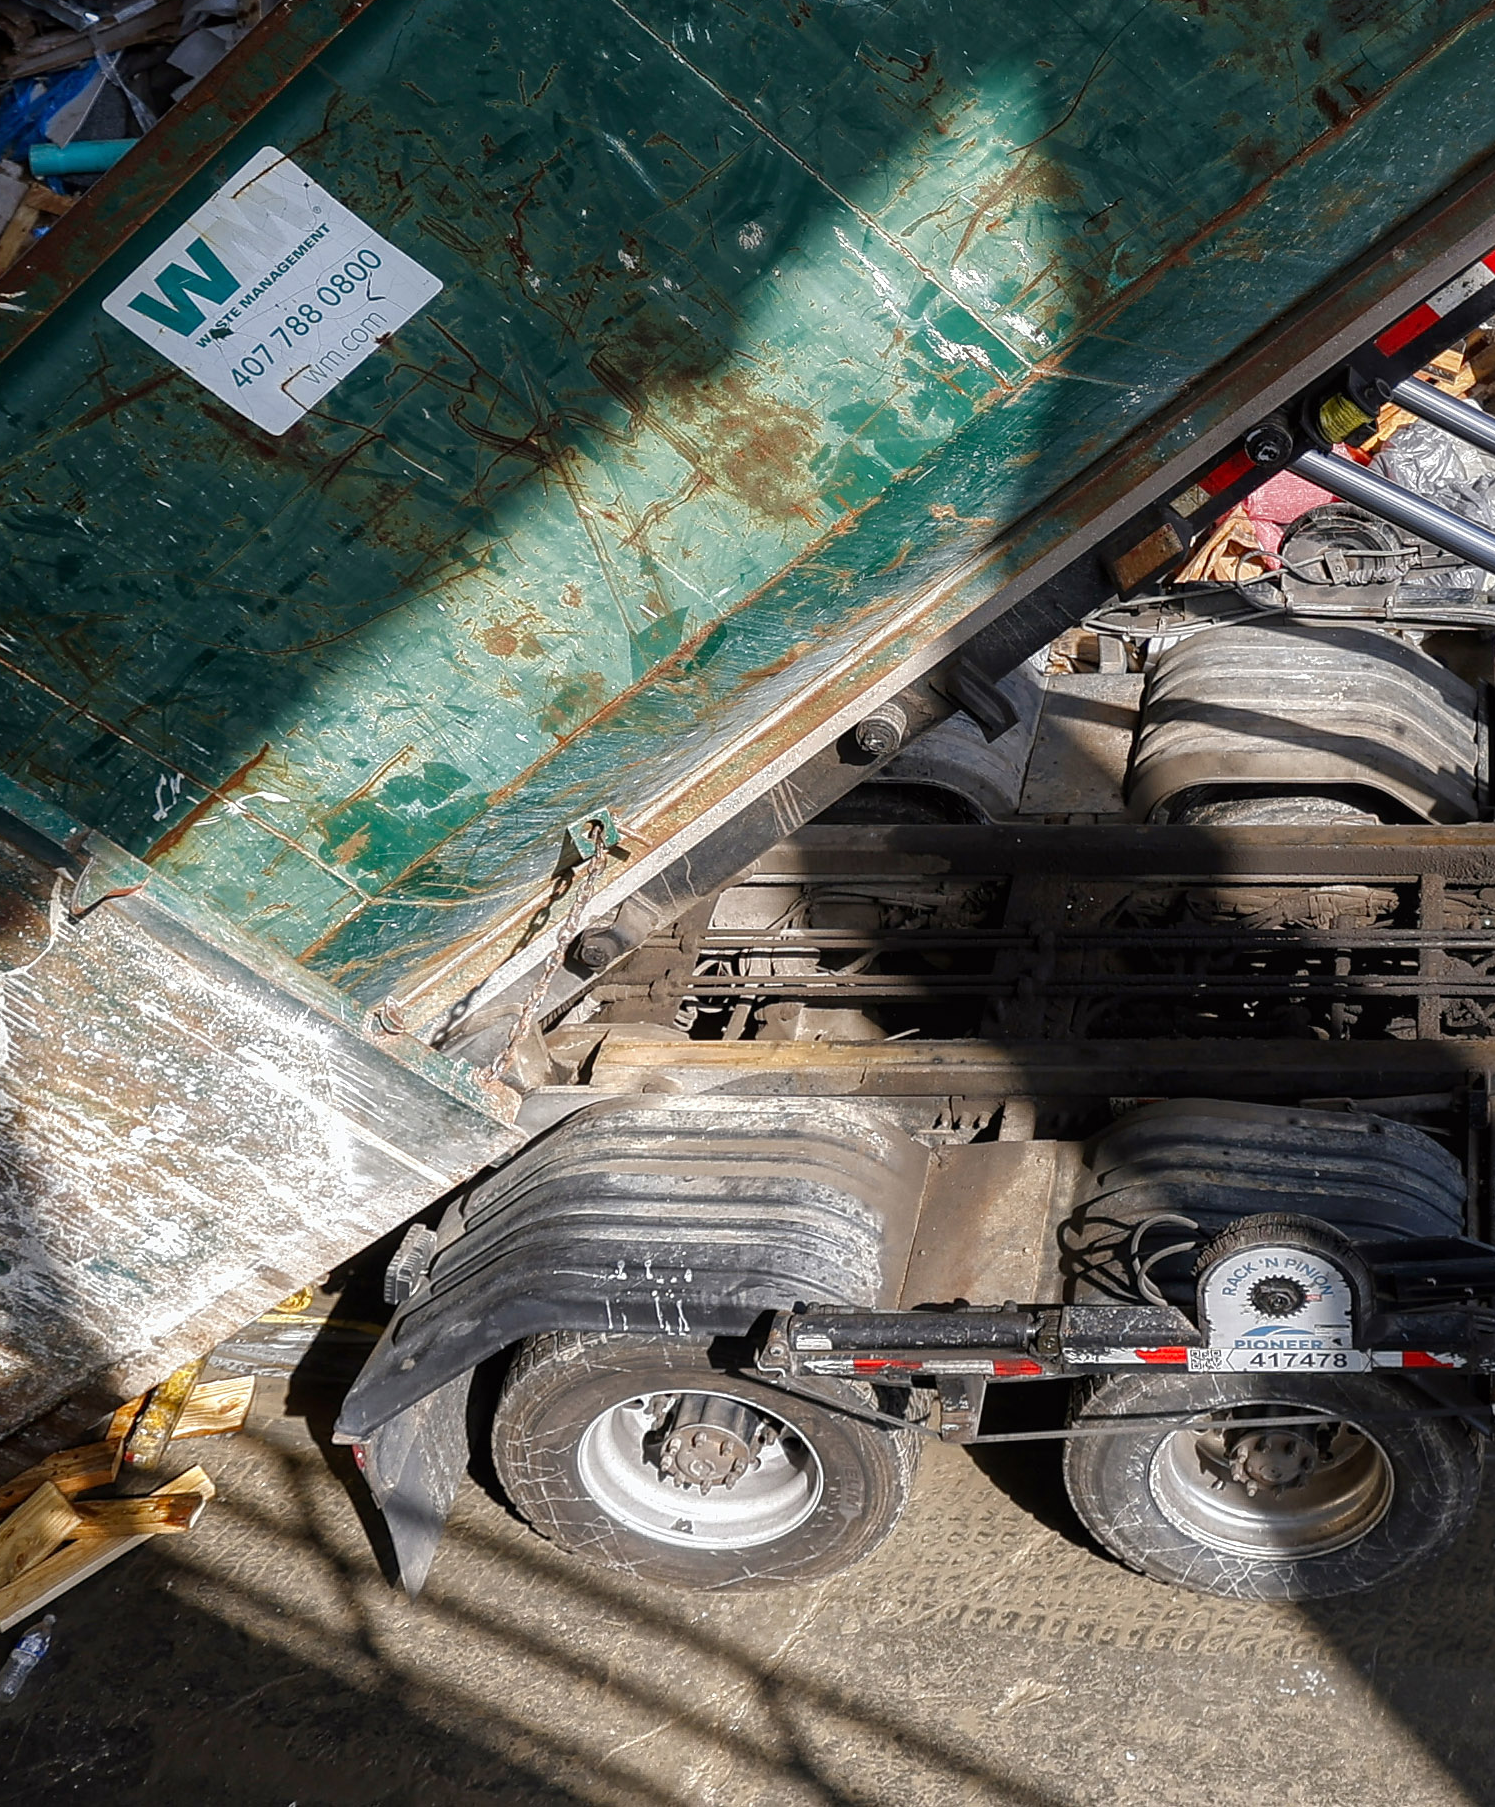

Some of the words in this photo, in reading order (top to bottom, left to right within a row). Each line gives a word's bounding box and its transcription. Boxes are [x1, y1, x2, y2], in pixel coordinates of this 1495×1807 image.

[240, 222, 331, 310] MANAGEMENT
[230, 343, 275, 389] 407
[269, 303, 323, 349] 788
[316, 249, 382, 306] 0800
[302, 310, 388, 385] wm.com
[1222, 1261, 1258, 1297] RACK
[1284, 1257, 1335, 1297] PINION
[1234, 1339, 1323, 1349] PIONEER
[1249, 1352, 1349, 1368] 417478
